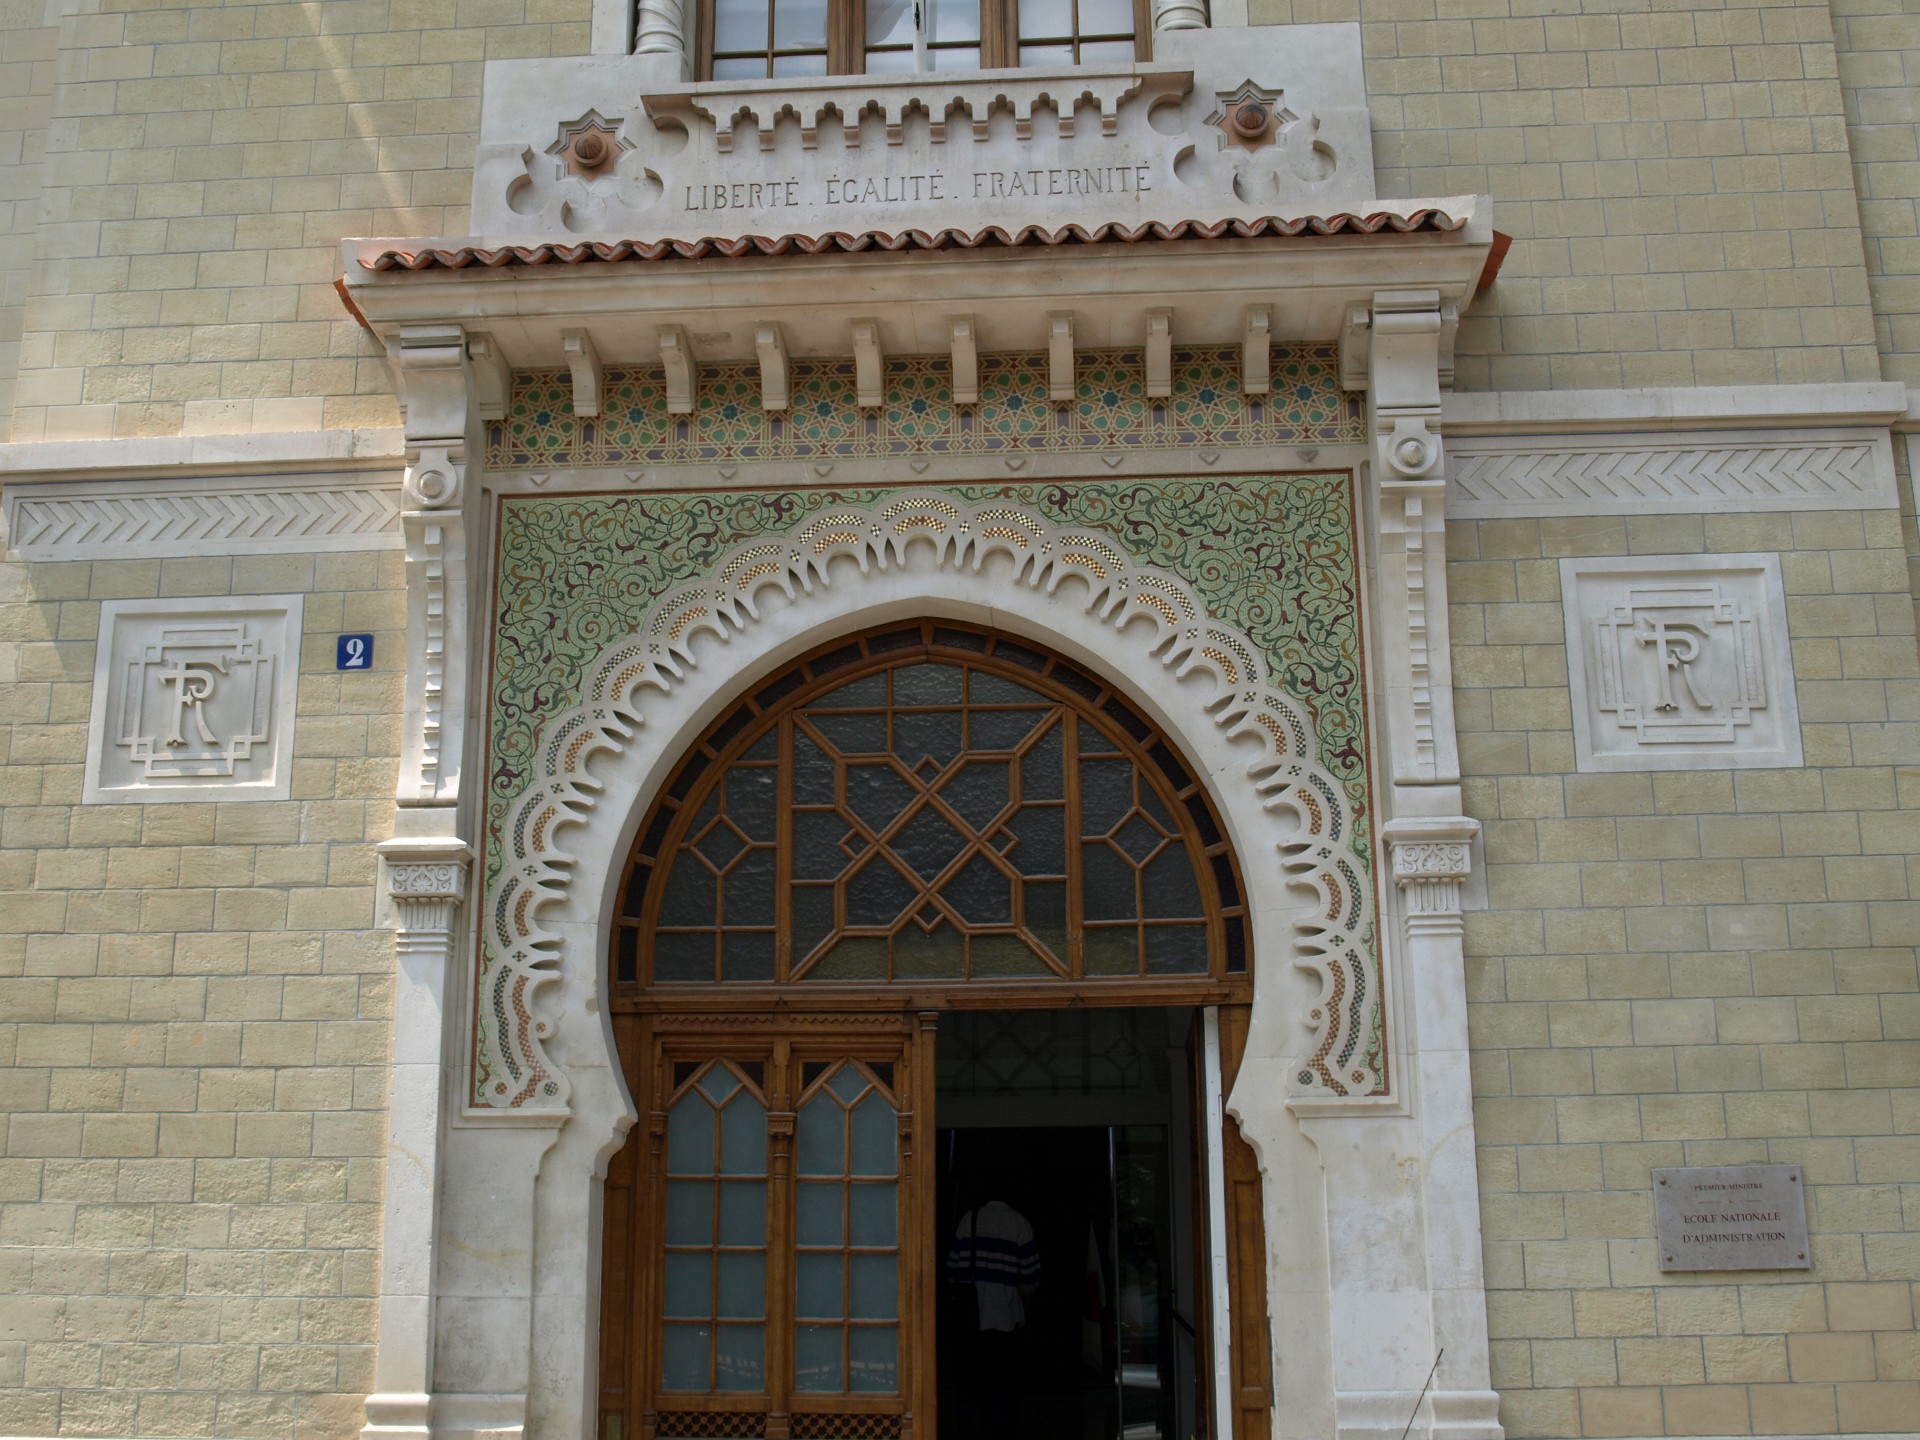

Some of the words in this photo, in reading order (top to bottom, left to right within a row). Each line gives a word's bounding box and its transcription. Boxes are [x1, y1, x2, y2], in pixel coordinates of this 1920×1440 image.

[684, 177, 799, 211] LIBERTÉ
[826, 169, 944, 205] ÉGALITÉ
[972, 161, 1151, 198] FRATERNITÉ
[346, 638, 364, 667] 2
[1684, 1214, 1717, 1224] ECOLE
[1721, 1212, 1781, 1223] NATIONALE
[1683, 1232, 1786, 1244] D'ADMINISTRATION
